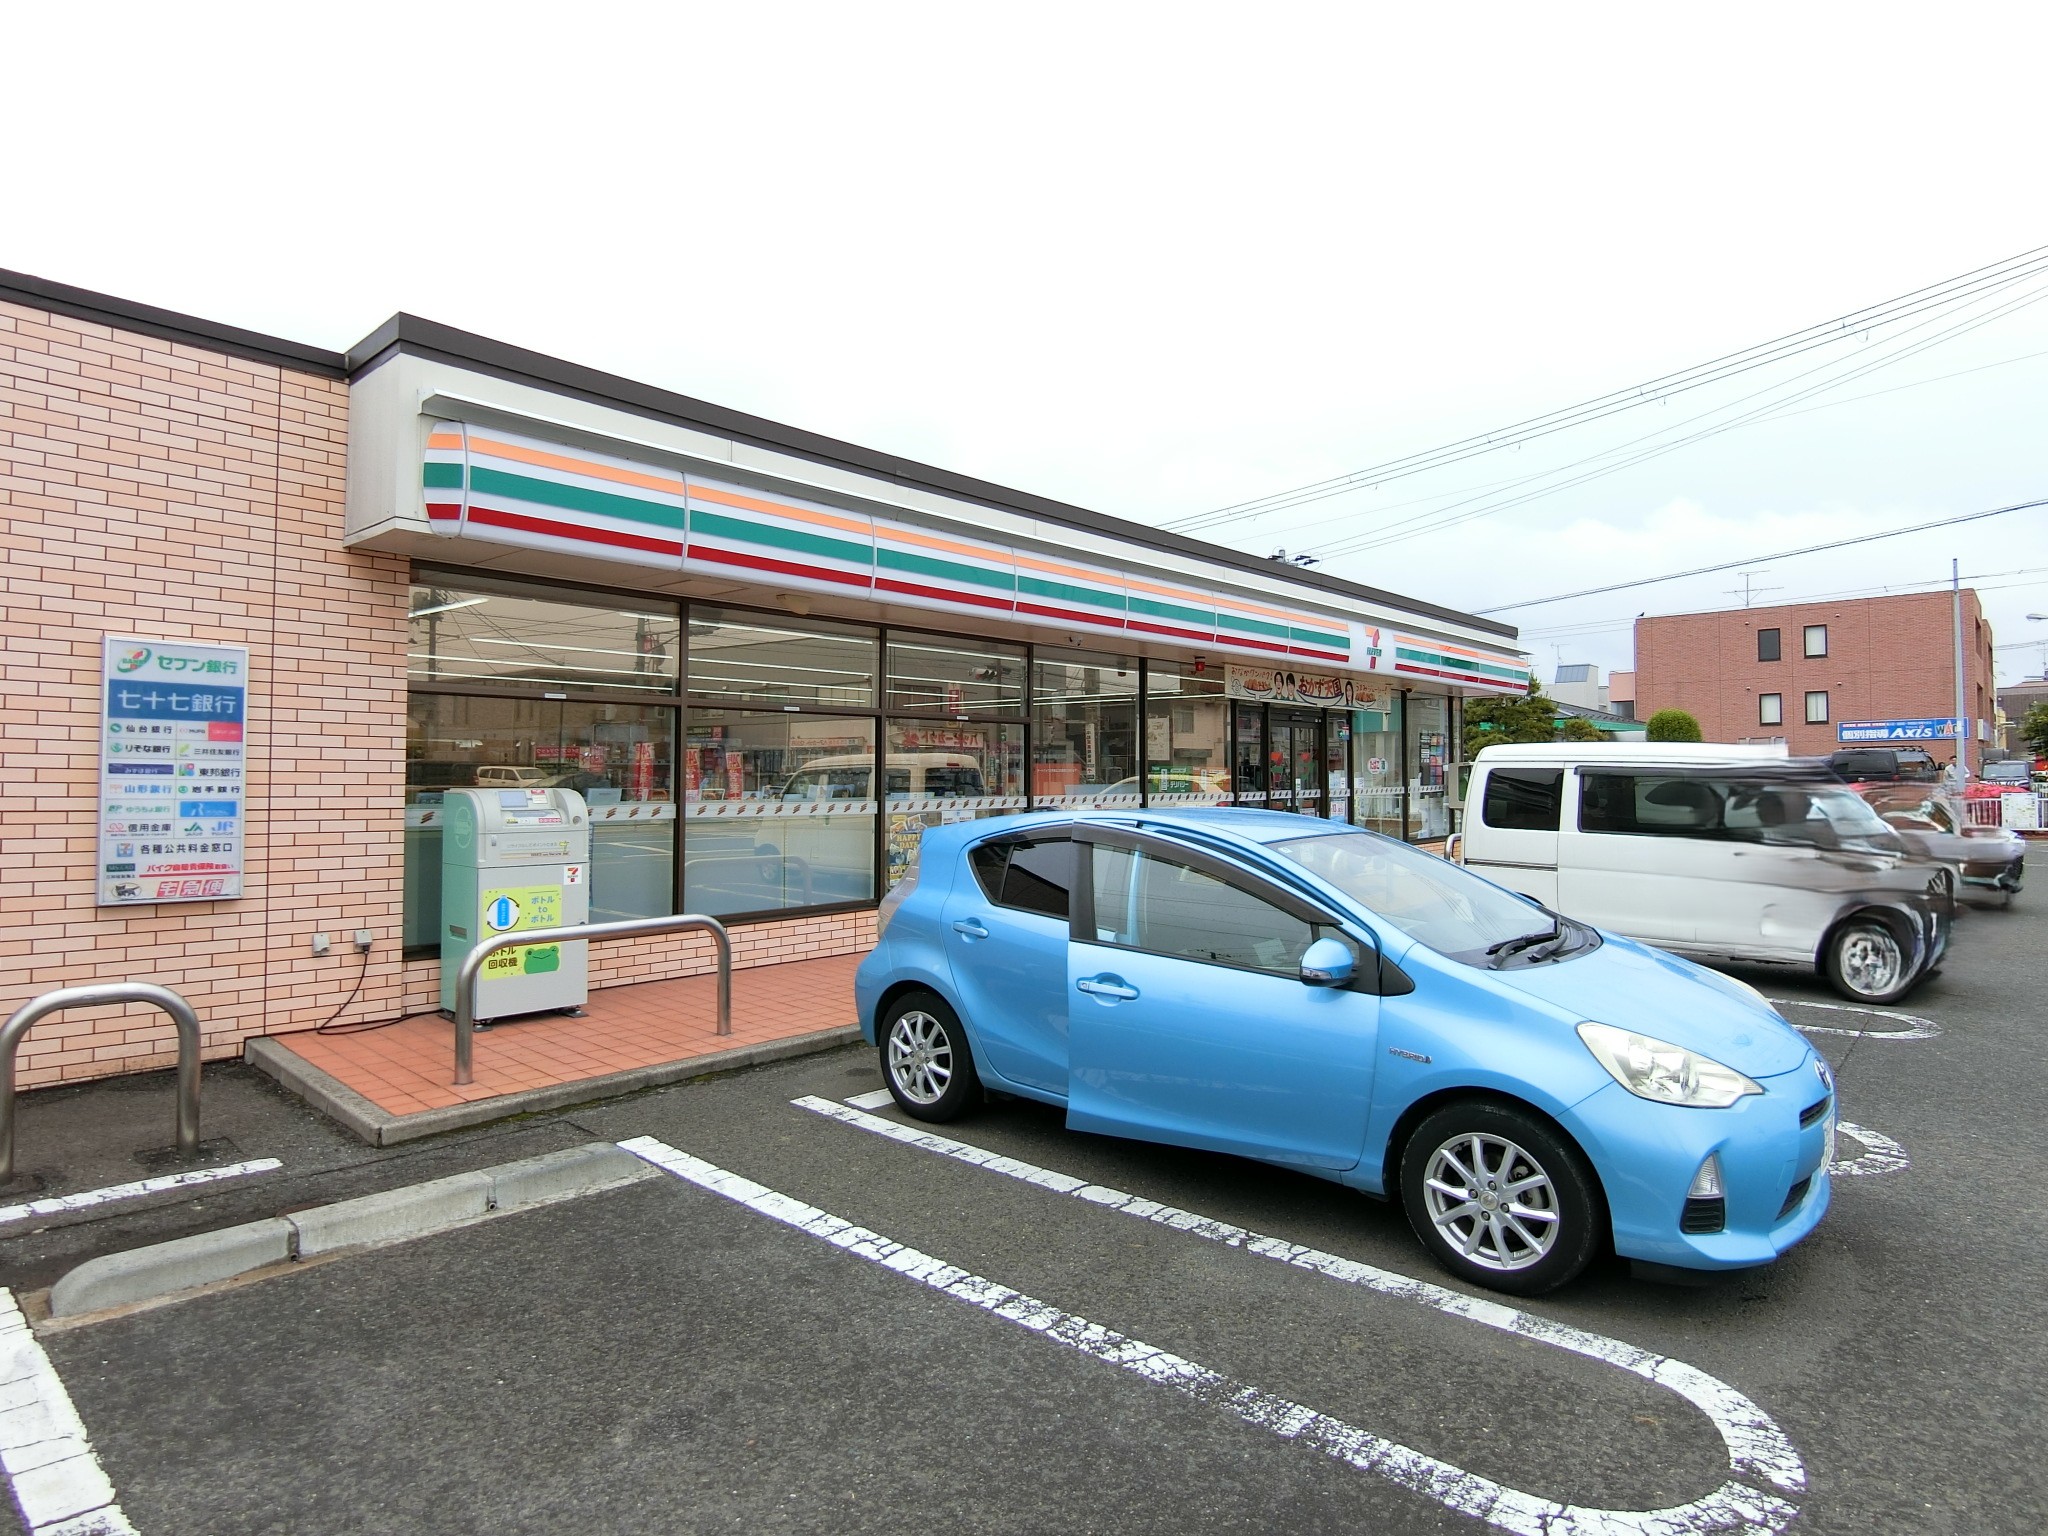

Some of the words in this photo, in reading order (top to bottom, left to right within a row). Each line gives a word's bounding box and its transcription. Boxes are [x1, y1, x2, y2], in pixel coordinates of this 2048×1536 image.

[157, 655, 238, 675] セブン銀行
[1299, 676, 1342, 697] おかず天国
[117, 689, 236, 713] 七十七銀行
[126, 724, 172, 734] 仙台銀行
[1842, 729, 1889, 739] 個別指導
[1890, 724, 1933, 739] Axis
[125, 745, 171, 754] りそな銀行
[194, 748, 240, 756] 三井住友銀行
[199, 768, 241, 778] 東邦銀行
[124, 784, 172, 794] 山形銀行
[128, 823, 172, 832] 信用金庫
[140, 843, 233, 854] 各種公共料金窓口
[157, 879, 224, 897] 宅急便
[531, 896, 555, 904] ボトル
[531, 915, 554, 924] ボトル
[488, 957, 518, 970] 回収機
[1388, 1046, 1425, 1063] HYBRID
